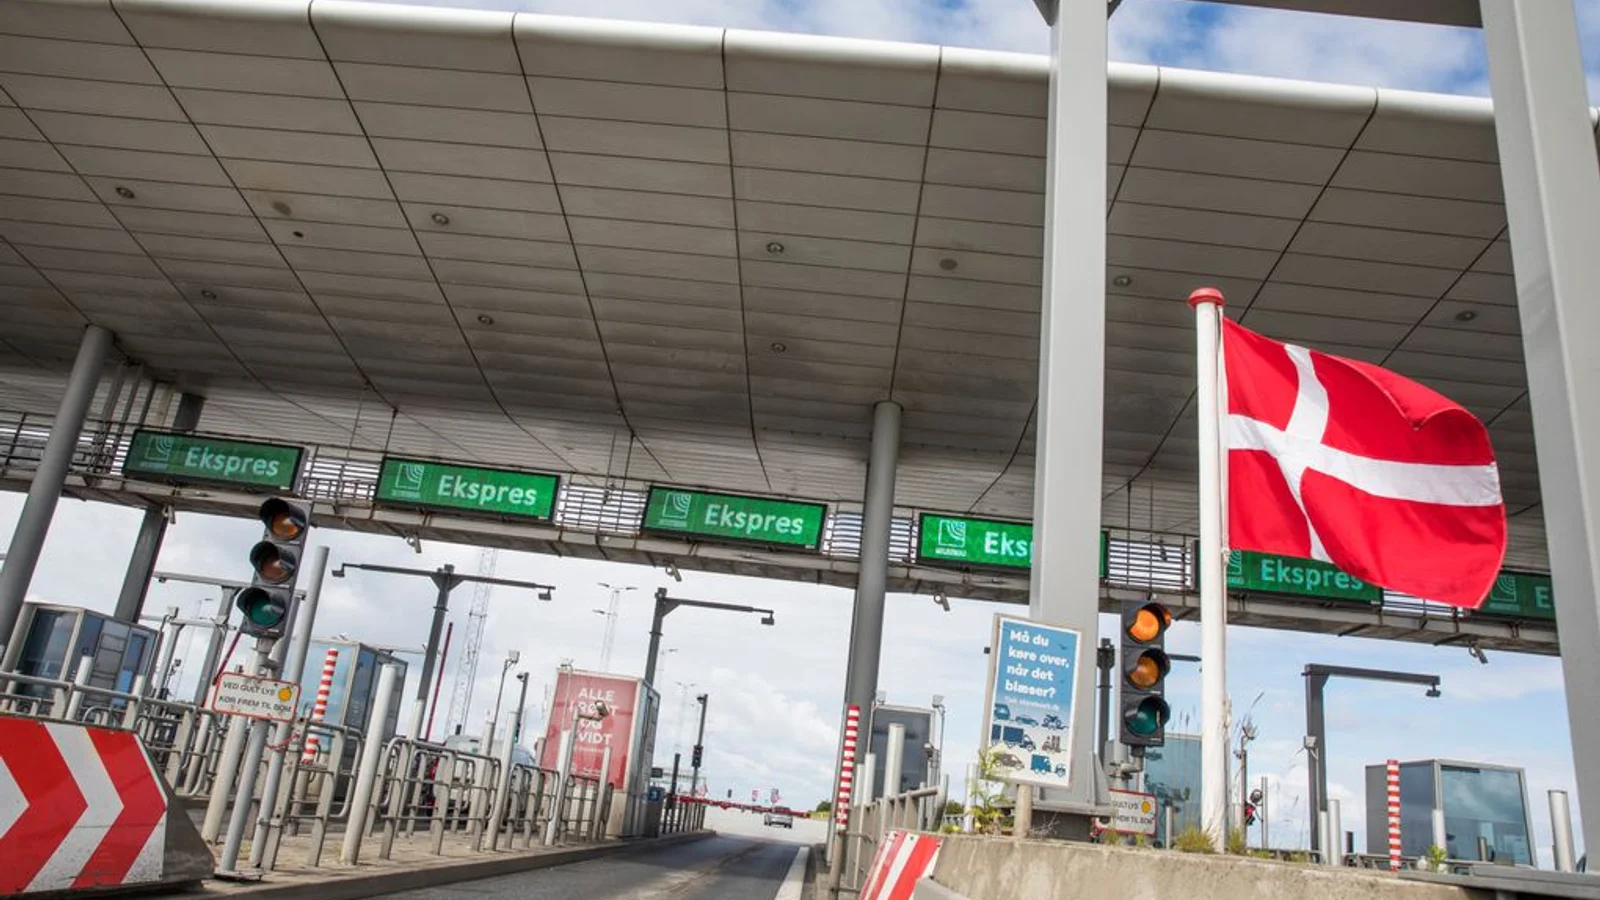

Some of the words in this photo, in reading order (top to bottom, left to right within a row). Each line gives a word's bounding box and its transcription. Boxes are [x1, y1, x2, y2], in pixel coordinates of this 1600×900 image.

[184, 446, 280, 477] Ekspres
[437, 474, 538, 506] Ekspres
[704, 503, 804, 535] Ekspres
[985, 531, 1033, 563] Eks
[1260, 558, 1363, 591] Ekspres
[1535, 586, 1551, 609] E
[1010, 629, 1030, 644] Må
[1032, 634, 1049, 646] du
[1008, 645, 1037, 661] køre
[1006, 663, 1029, 676] når
[1031, 667, 1054, 681] det
[578, 687, 616, 701] ALLE
[1005, 679, 1056, 698] blæser?
[579, 731, 613, 746] VIDT
